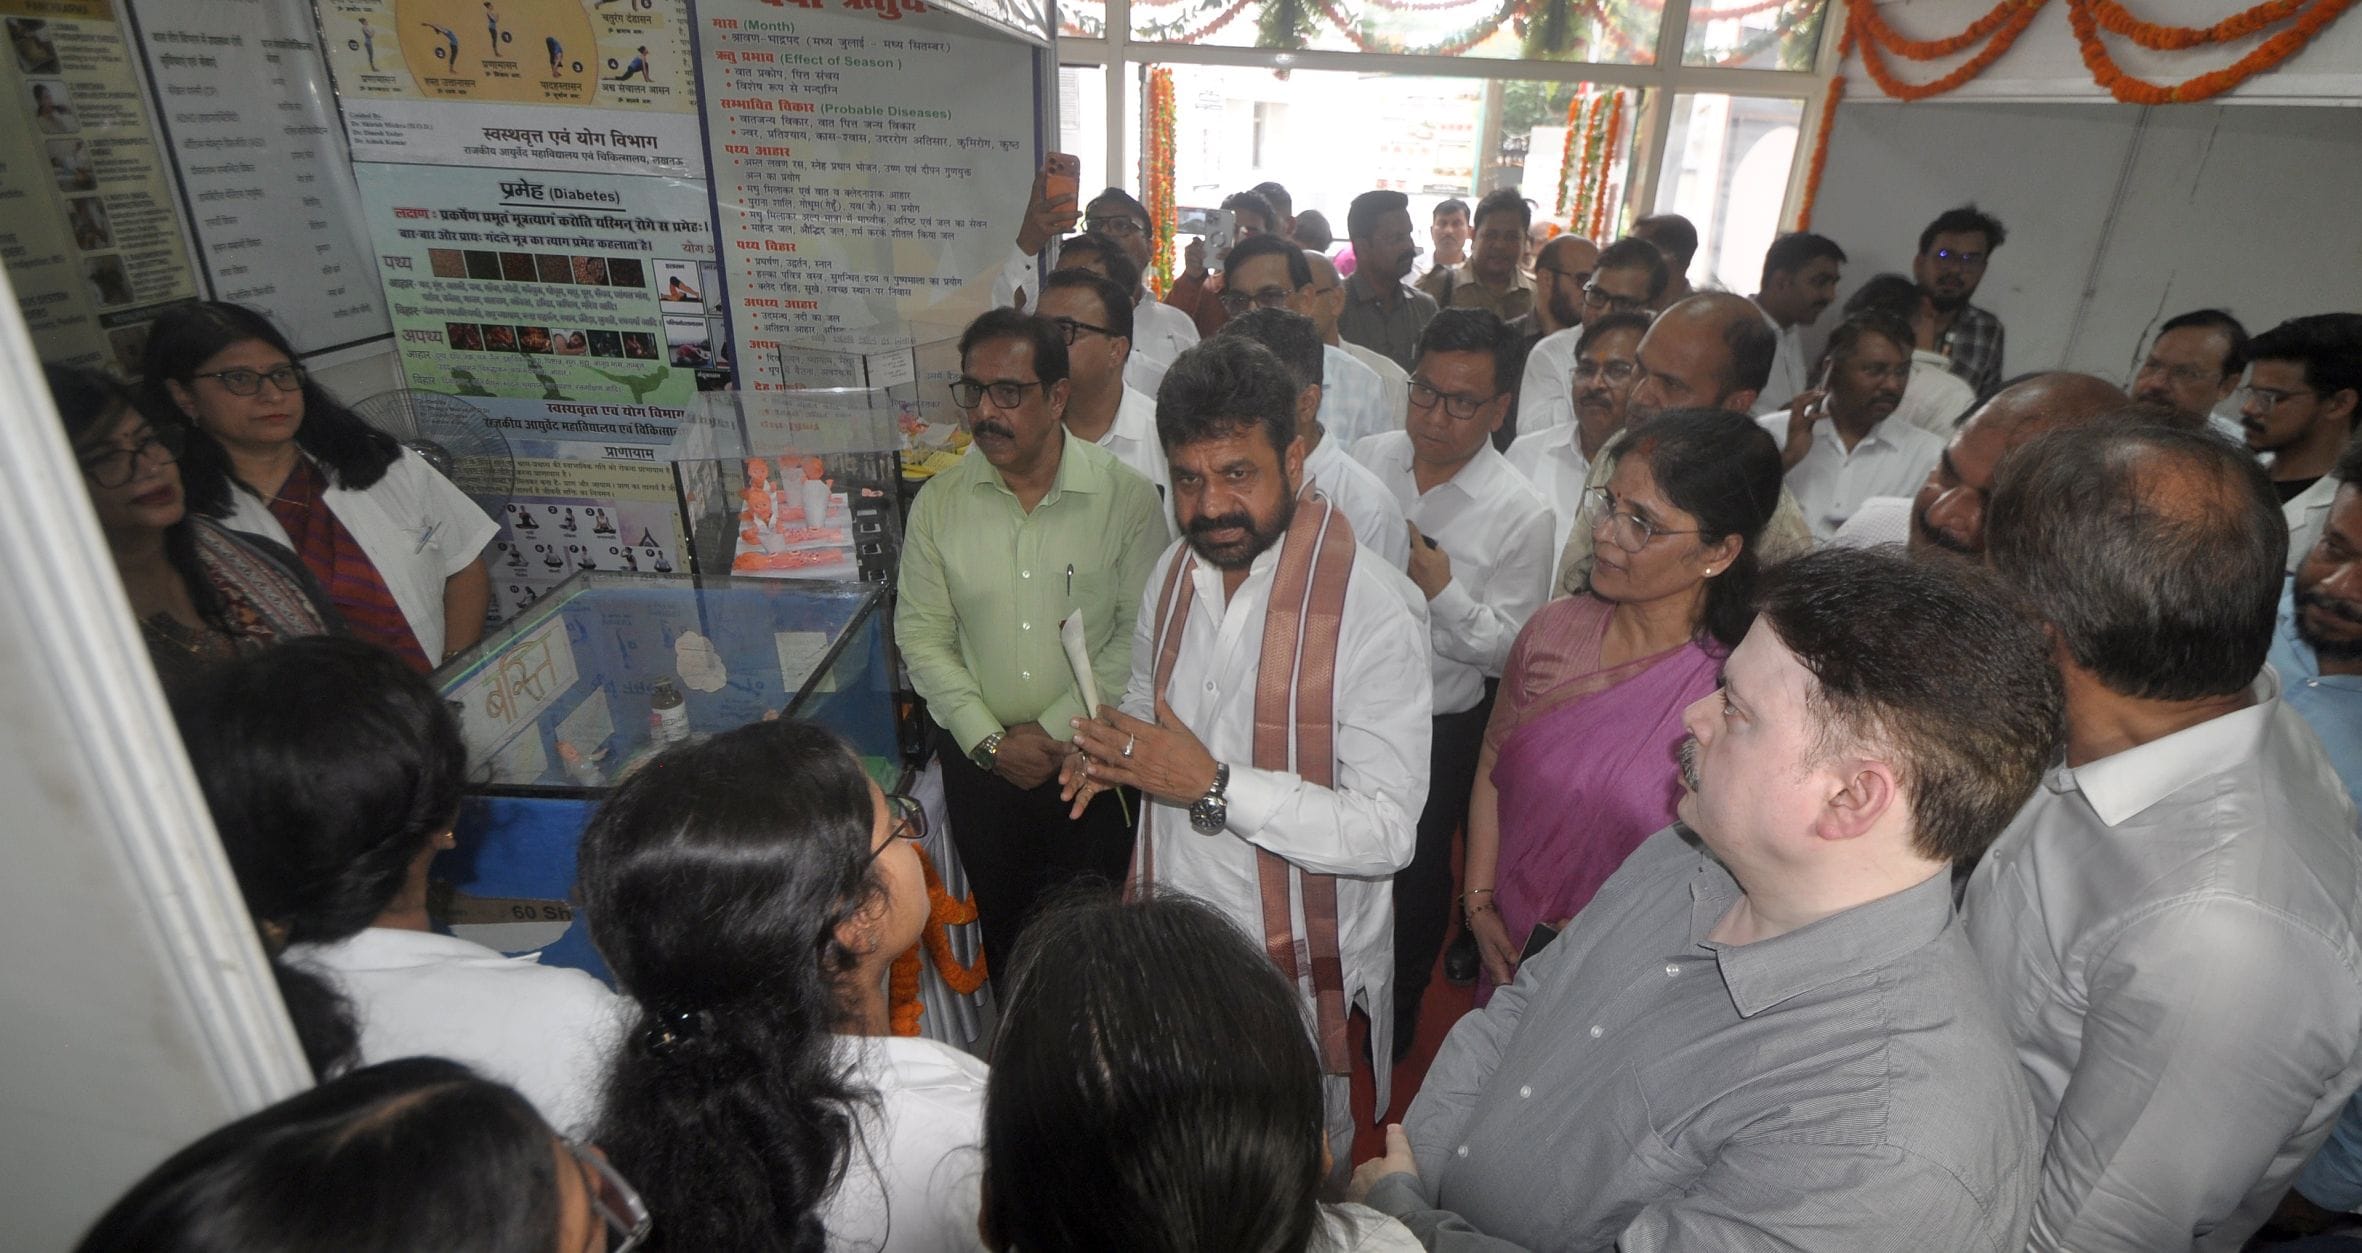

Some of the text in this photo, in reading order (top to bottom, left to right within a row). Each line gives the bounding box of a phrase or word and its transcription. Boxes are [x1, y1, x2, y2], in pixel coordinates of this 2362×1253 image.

[712, 18, 795, 33] मास (Month)
[732, 32, 800, 46] श्रावण-भाद्रपद
[838, 37, 865, 49] जुलाई
[883, 39, 904, 50] मध्य
[715, 51, 894, 68] ऋतु प्रभाव (Effect of Season
[735, 68, 752, 77] वात
[815, 68, 840, 81] संचय
[736, 80, 763, 92] विशेष
[768, 82, 785, 93] रूप
[790, 80, 798, 93] से
[720, 98, 952, 120] सम्भावित विकार (Probable Diseases)
[482, 127, 658, 149] स्वस्थवृत्त एवं योग विभाग
[464, 144, 496, 156] राजकीय
[500, 146, 529, 160] आयुर्वेद
[531, 148, 579, 160] महाविद्यालय
[581, 148, 594, 161] एवं
[755, 145, 791, 157] आहार
[500, 178, 621, 205] प्रमेह (Diabetes)
[438, 229, 456, 241] और
[681, 239, 704, 254] योग
[765, 240, 797, 252] विहार
[383, 254, 413, 272] पथ्य
[784, 299, 818, 310] आहार
[402, 329, 443, 345] अपथ्य
[601, 403, 620, 417] एवं
[622, 405, 646, 417] योग
[604, 446, 654, 458] प्राणायाम
[512, 905, 572, 920] 60 Sh
